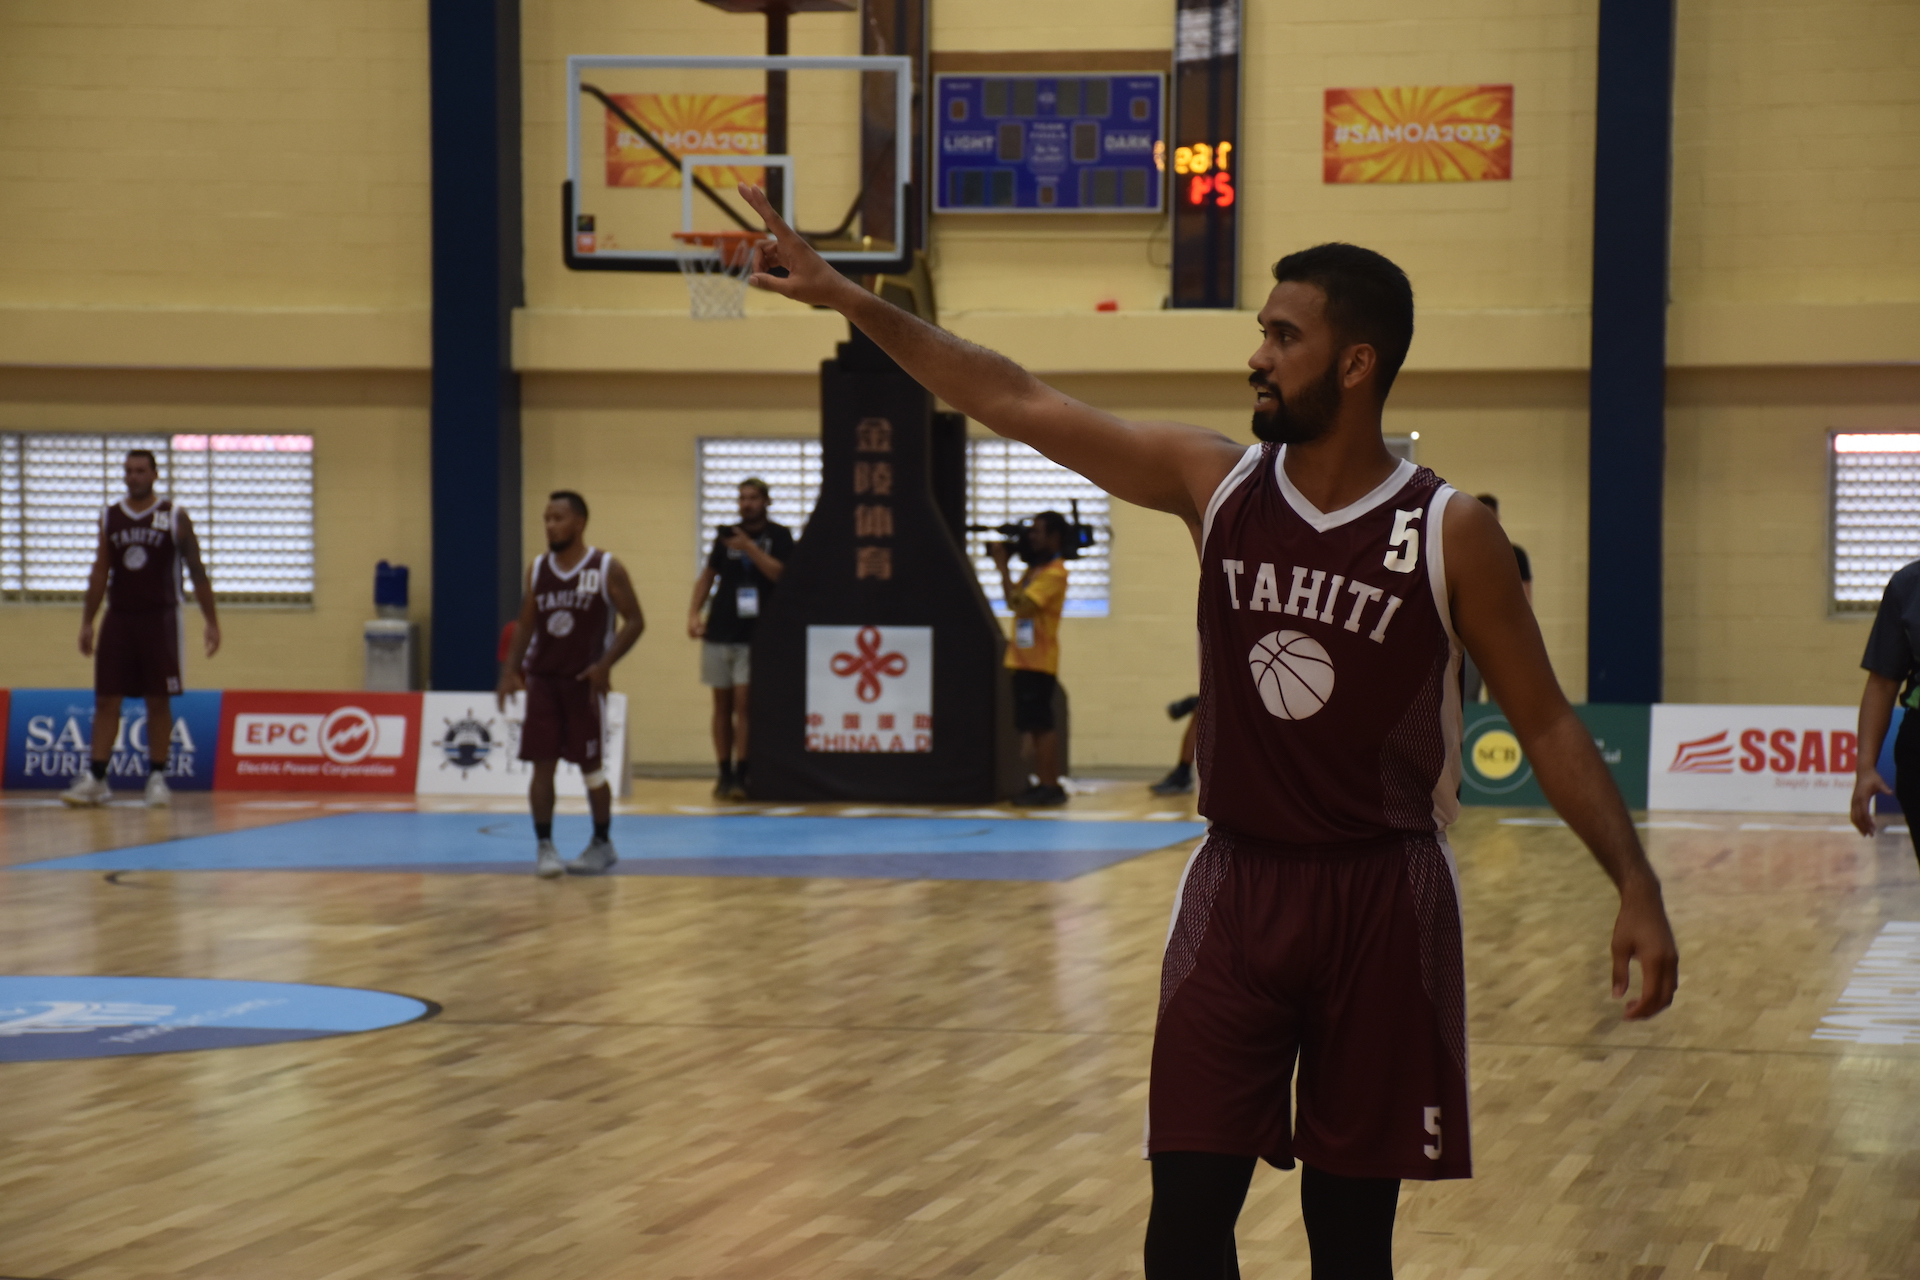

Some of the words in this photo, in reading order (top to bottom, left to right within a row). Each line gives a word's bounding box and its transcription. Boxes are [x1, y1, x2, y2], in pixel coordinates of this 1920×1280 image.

[616, 130, 767, 149] #SMOA201
[1335, 123, 1501, 143] #SAMOA2019
[1383, 507, 1423, 574] 5
[577, 569, 600, 593] 10
[1222, 559, 1403, 644] TAHITI
[246, 724, 308, 744] EPC
[806, 733, 881, 750] CHINA
[106, 752, 195, 777] WAER
[1423, 1106, 1442, 1160] 5
